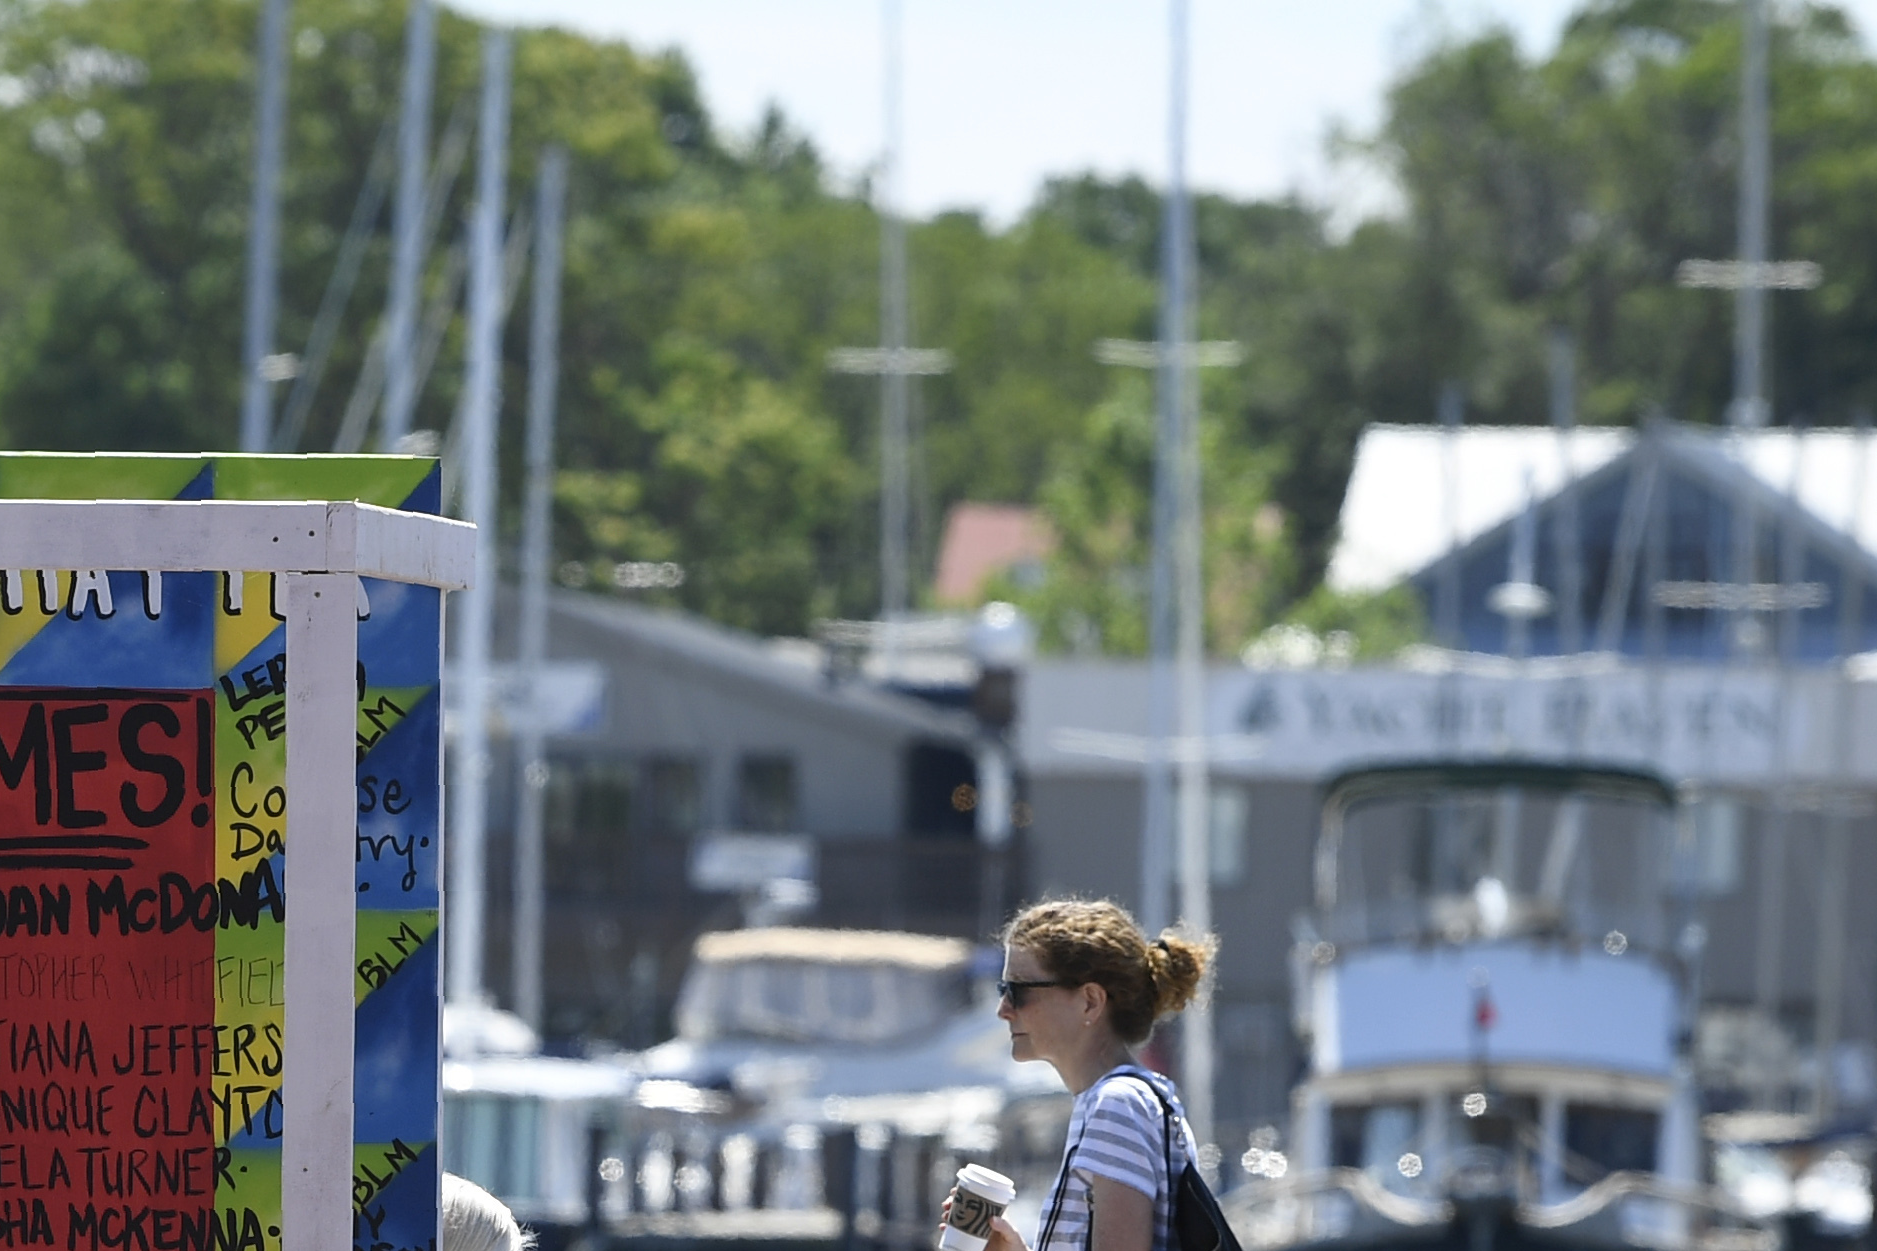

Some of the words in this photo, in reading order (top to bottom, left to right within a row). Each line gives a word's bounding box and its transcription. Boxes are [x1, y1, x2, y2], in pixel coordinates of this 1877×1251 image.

[358, 921, 423, 988] BLM
[77, 1146, 237, 1199] TURNER
[352, 1136, 418, 1209] BLM
